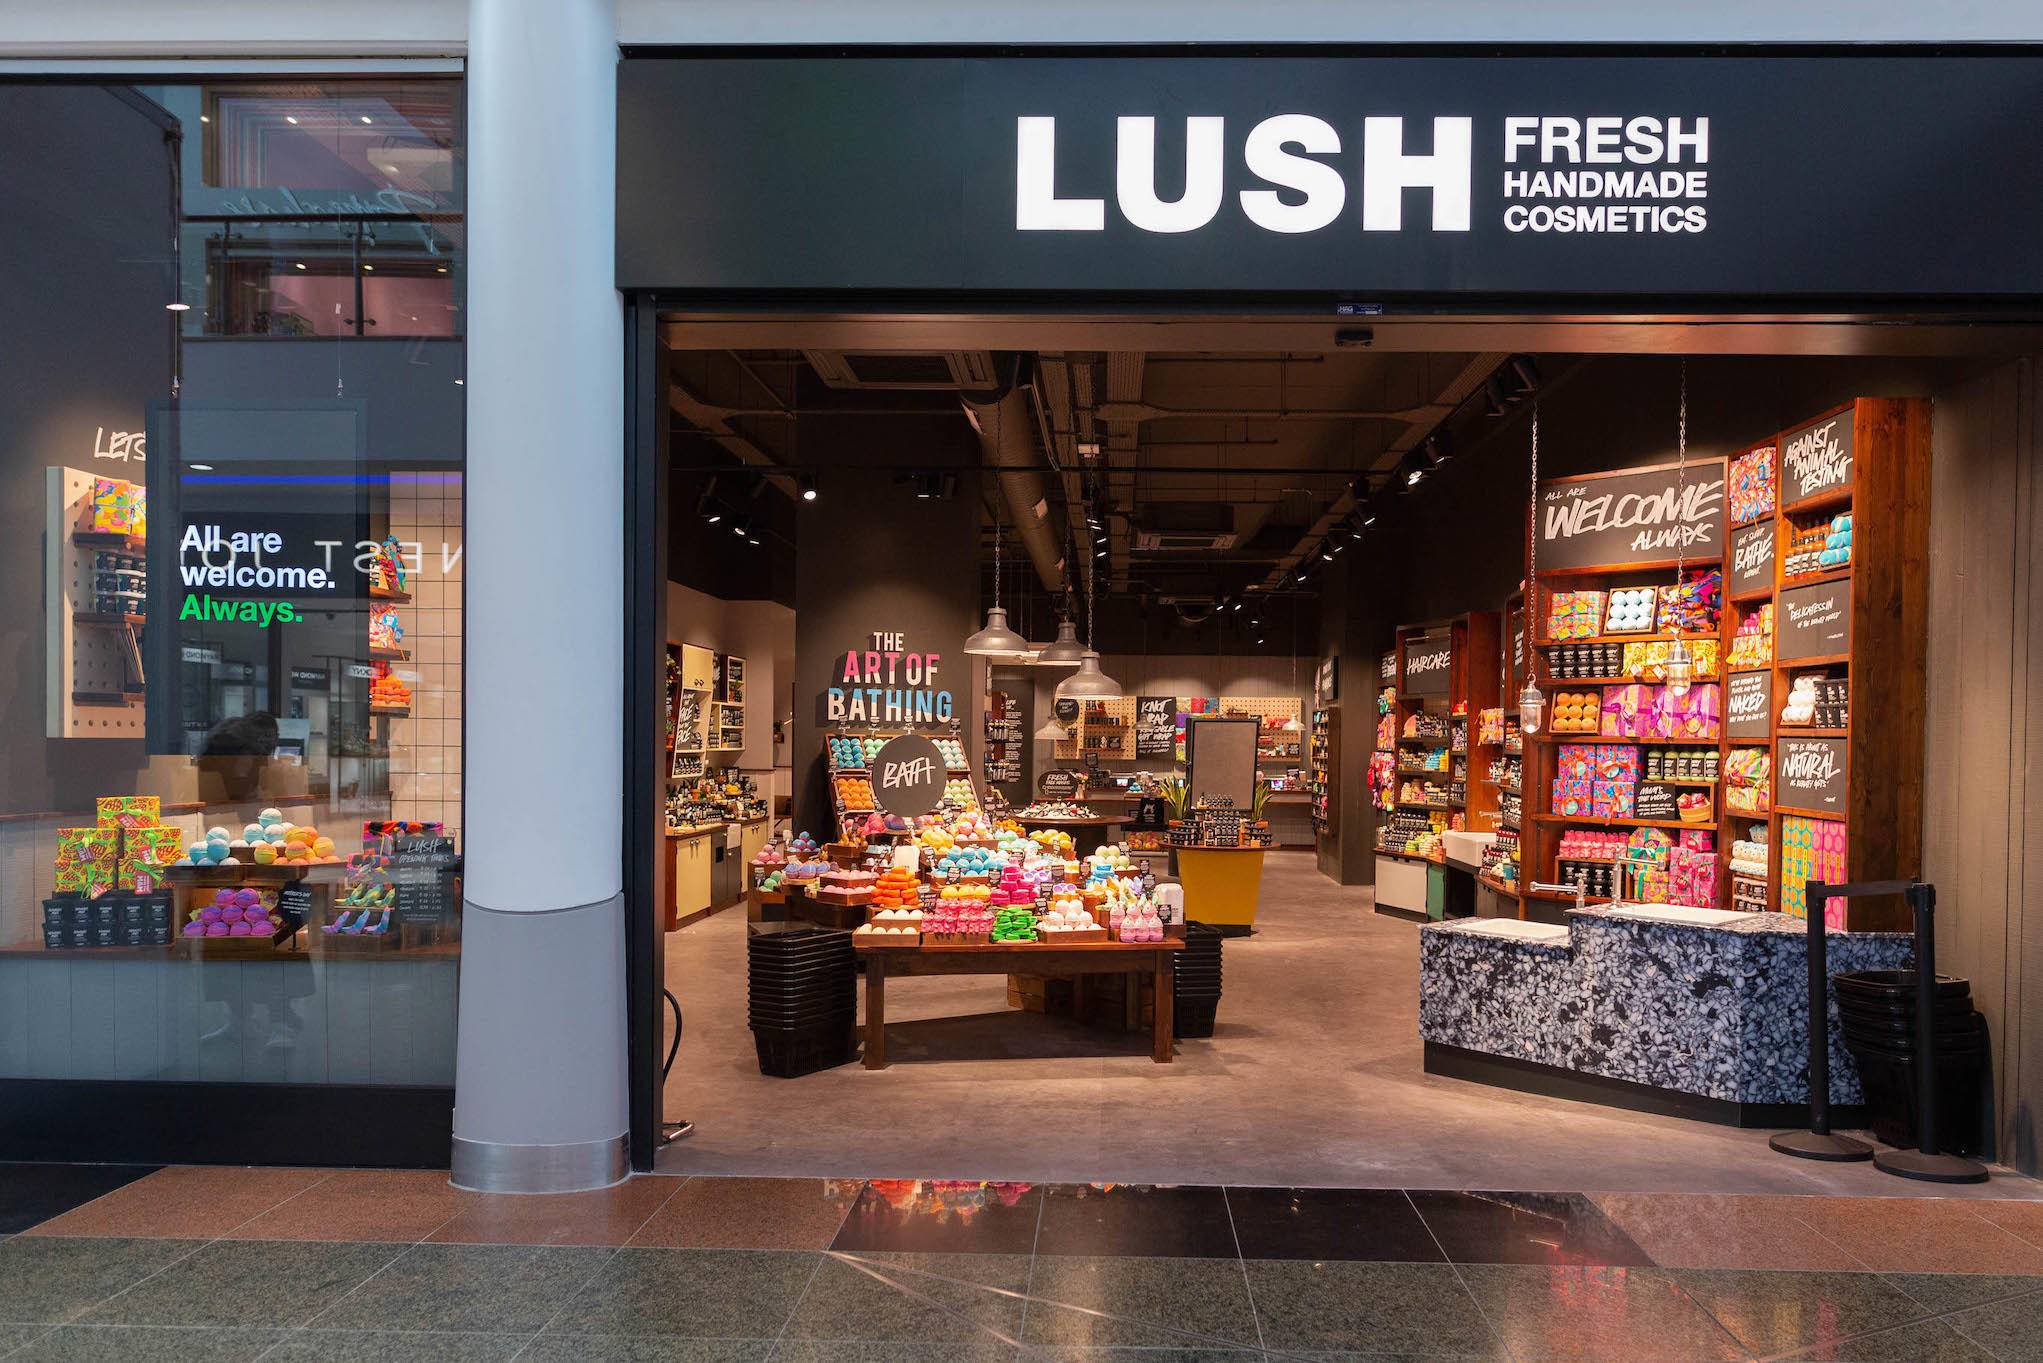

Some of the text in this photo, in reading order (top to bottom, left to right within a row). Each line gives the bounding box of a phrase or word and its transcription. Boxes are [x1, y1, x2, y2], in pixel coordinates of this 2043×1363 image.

[1505, 117, 1708, 164] FRESH
[1017, 114, 1472, 233] LUSH
[1504, 171, 1707, 197] HANDMADE
[1504, 205, 1706, 232] COSMETICS
[1784, 421, 1836, 467] AGAINST
[1794, 439, 1844, 480] ANIMAL
[1800, 456, 1853, 496] TESTING
[1545, 487, 1587, 500] ALL ARE
[1545, 480, 1724, 540] WELCOME
[180, 525, 282, 553] All are
[1631, 522, 1714, 551] ALWAYS
[1735, 532, 1775, 572] BATHE.
[180, 560, 335, 589] welcome.
[179, 594, 303, 628] Always.
[874, 632, 904, 651] THE
[843, 650, 940, 686] ART OF
[1407, 650, 1451, 676] HAIRCARE
[828, 688, 952, 723] BATHING
[1141, 698, 1172, 713] KNOT
[1728, 691, 1766, 714] NAKED
[1147, 712, 1169, 725] RAP
[883, 757, 936, 788] BATH
[1782, 750, 1841, 780] NATURAL
[407, 839, 442, 853] LUSH
